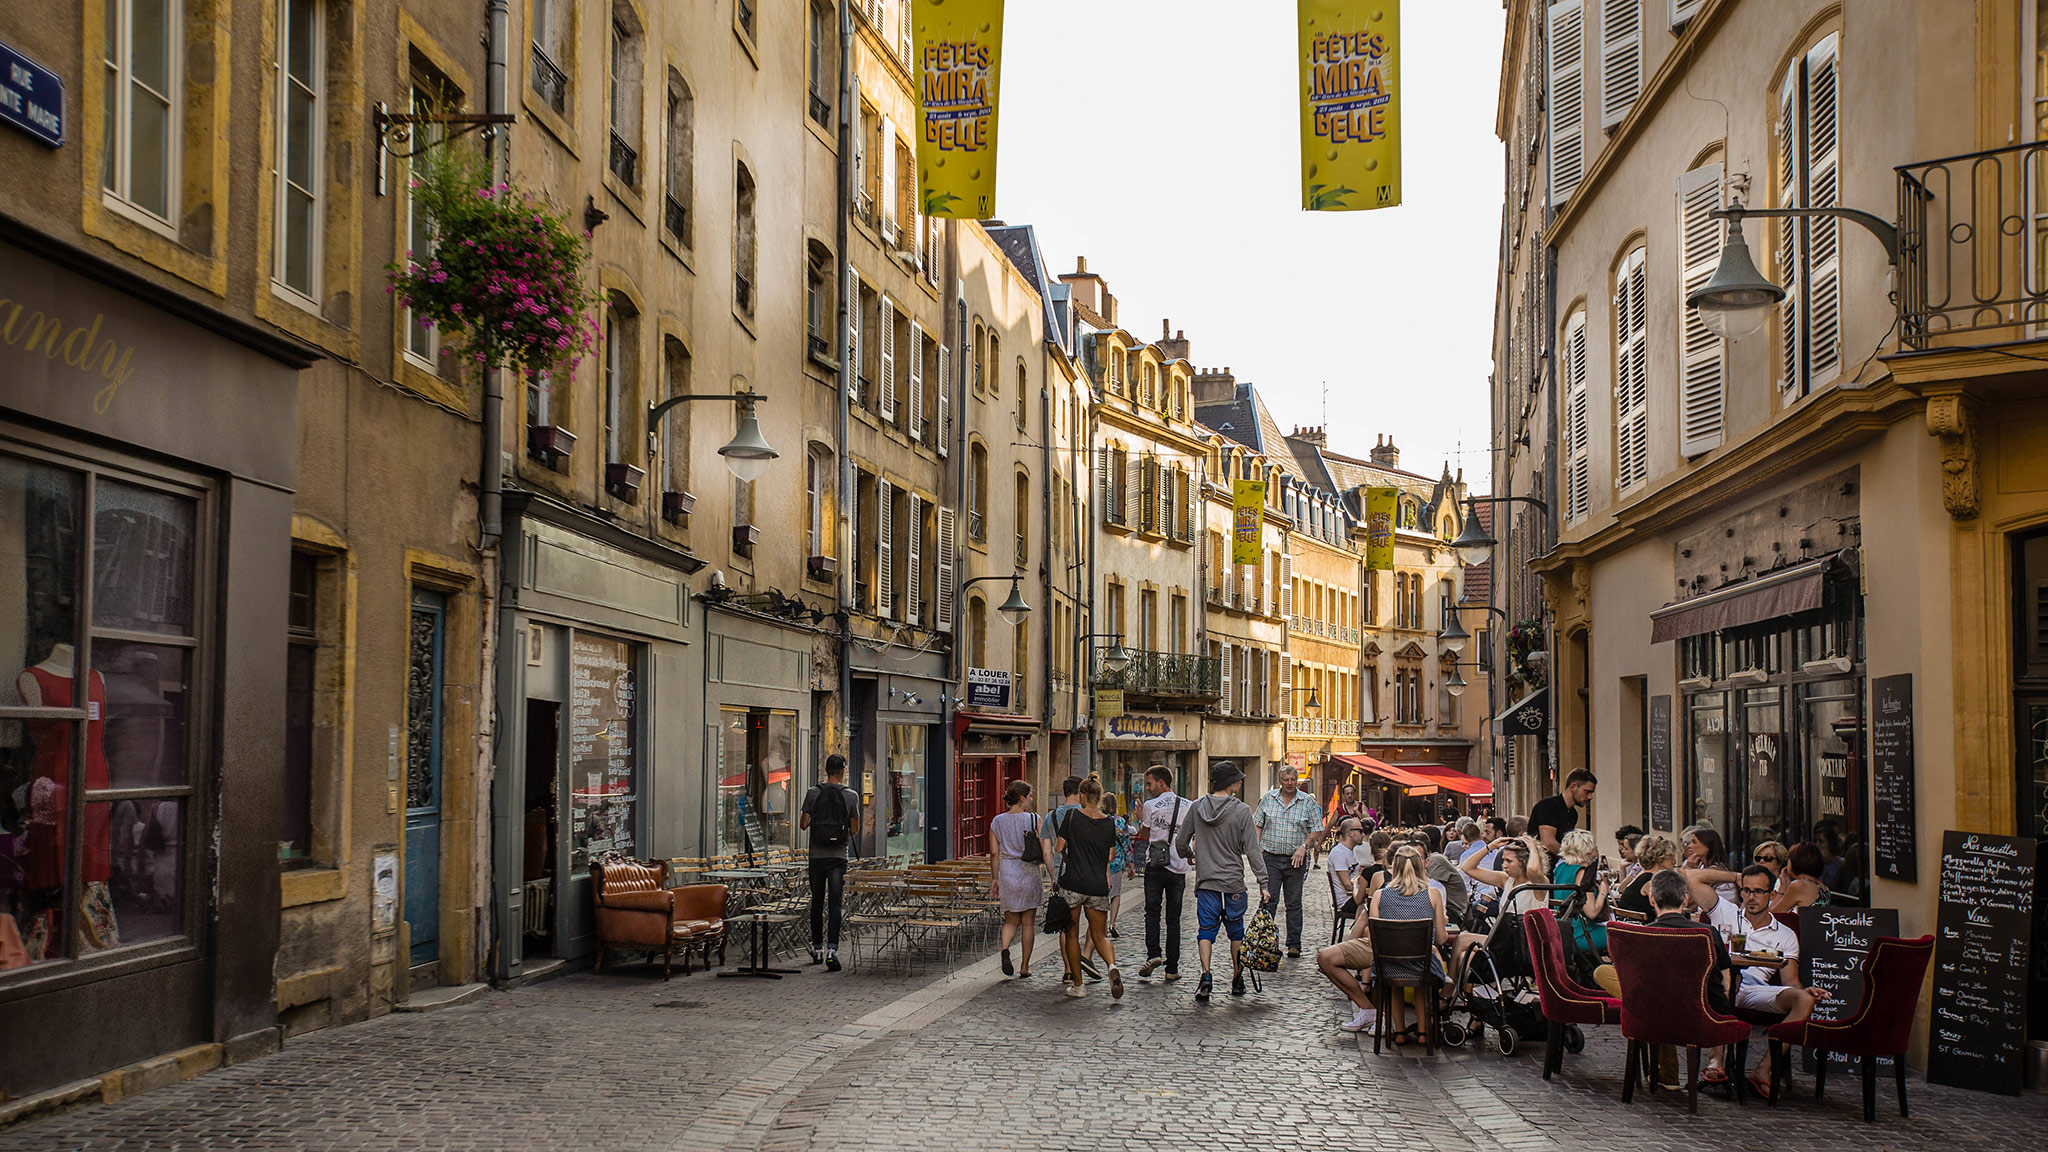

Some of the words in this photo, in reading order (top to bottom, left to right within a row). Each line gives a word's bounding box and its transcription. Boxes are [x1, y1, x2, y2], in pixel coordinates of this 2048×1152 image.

[924, 40, 990, 71] FÊTES
[1313, 30, 1385, 63] FÊTES
[11, 61, 33, 92] RUE
[925, 69, 989, 107] MIRA
[1313, 59, 1385, 97] MIRA
[28, 99, 60, 135] MARIE
[1313, 107, 1386, 144] BELLE
[926, 118, 988, 152] BELLE
[979, 670, 1008, 678] LOUER
[975, 685, 1000, 695] abel
[1116, 719, 1165, 735] STARGAME
[1818, 758, 1847, 778] COCKTAILS
[1962, 834, 1980, 851] Nos
[1983, 843, 2018, 857] assiettes
[1819, 911, 1875, 931] Spécialité
[1968, 906, 1990, 924] Vins
[1825, 930, 1868, 947] Mojitos
[1812, 979, 1839, 990] Kiwi
